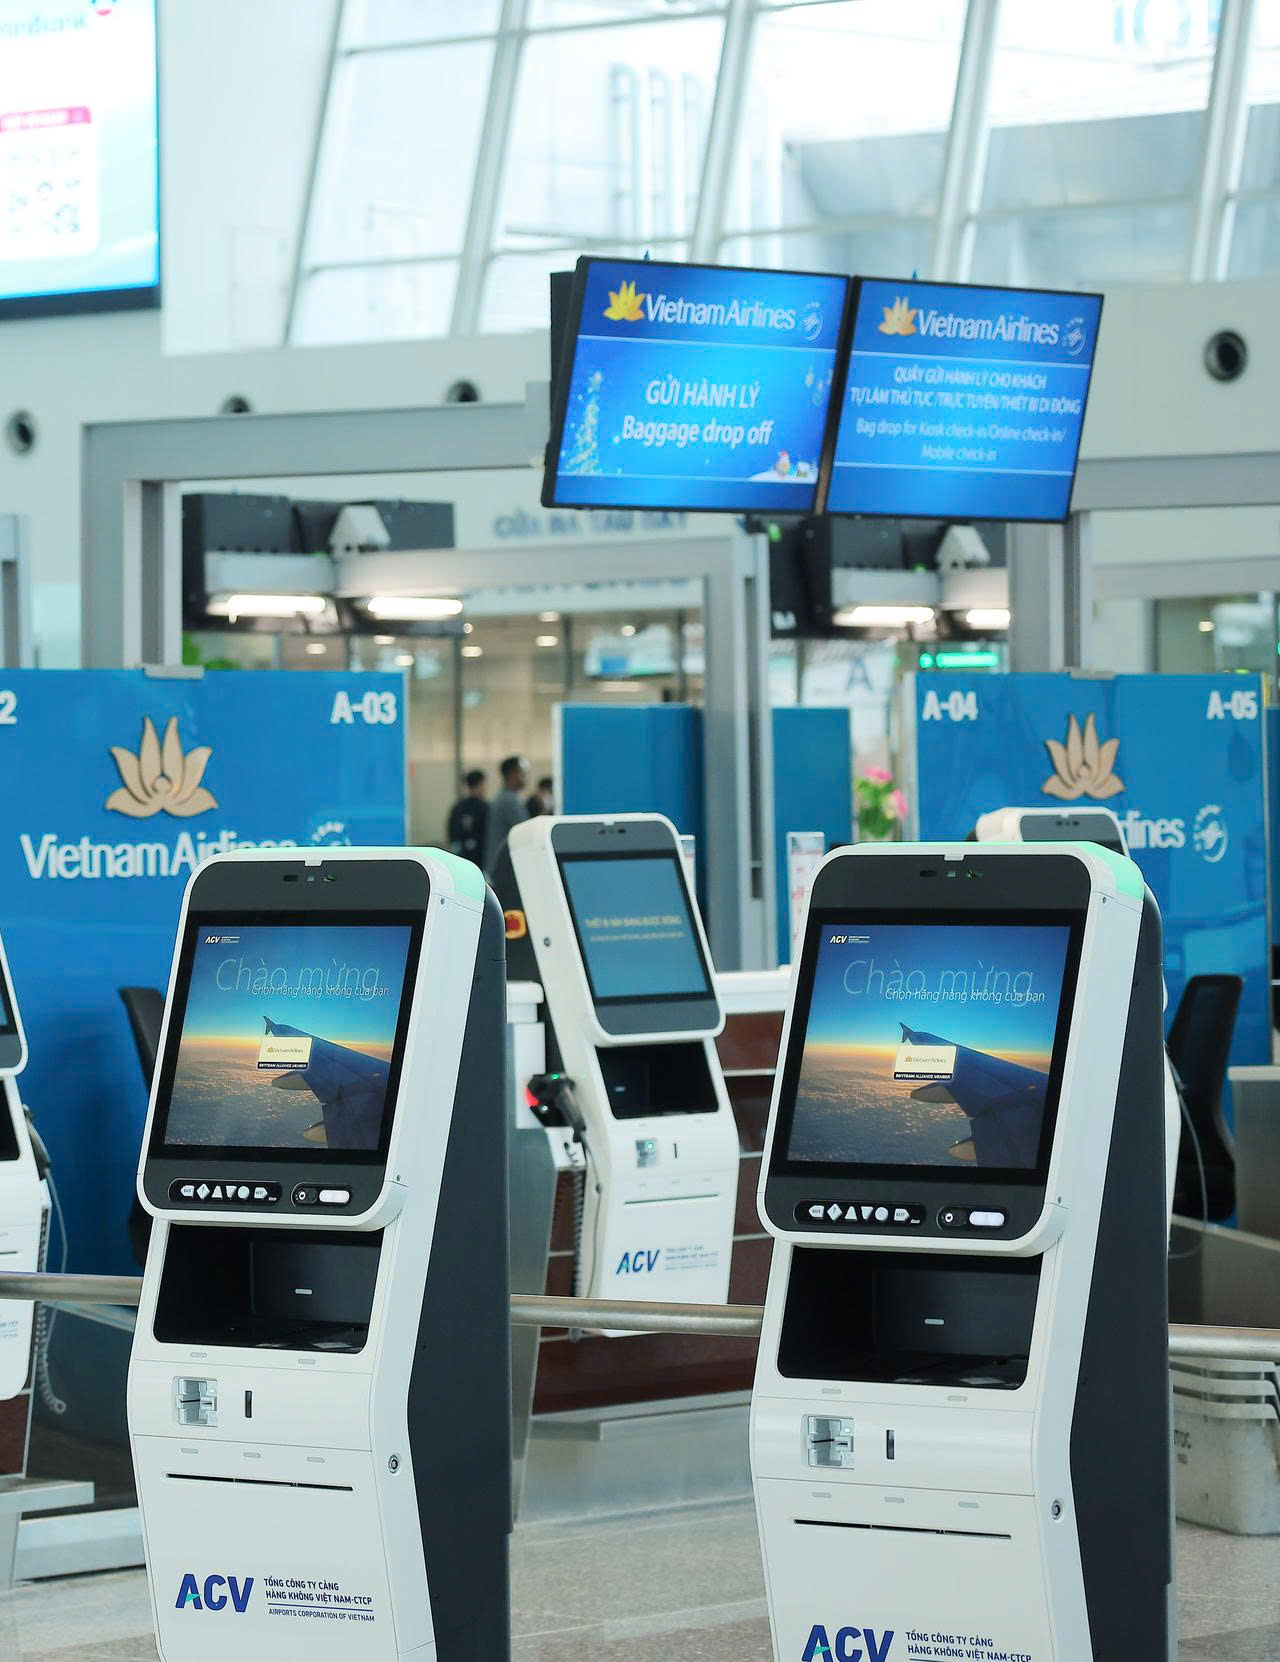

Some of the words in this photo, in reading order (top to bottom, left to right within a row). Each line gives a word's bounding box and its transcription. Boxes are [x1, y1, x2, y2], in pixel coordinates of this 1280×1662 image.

[645, 373, 680, 405] GỬI
[682, 377, 736, 408] HÀNH
[739, 380, 760, 409] LÝ
[622, 415, 700, 448] Baggage
[703, 417, 744, 448] drop
[747, 419, 774, 445] off
[331, 691, 397, 724] A-03
[923, 691, 978, 721] A-04
[1207, 691, 1257, 719] A-05
[20, 832, 171, 880] Vietnam
[204, 936, 221, 944] ACV
[829, 935, 848, 944] ACV
[216, 957, 287, 991] Chào
[298, 957, 380, 1001] mừng
[325, 983, 352, 998] không
[372, 984, 390, 997] bạn
[843, 959, 926, 995] Chào
[939, 960, 1033, 1007] mừng
[885, 987, 912, 1001] Chọn
[942, 988, 968, 1003] hàng
[971, 988, 1002, 1003] không
[1004, 988, 1024, 1001] của
[1026, 988, 1045, 1003] bạn
[616, 1250, 660, 1275] ACV
[175, 1573, 255, 1613] ACV
[263, 1575, 284, 1588] TỔNG
[285, 1578, 306, 1589] CÔNG
[307, 1581, 317, 1590] TY
[318, 1579, 339, 1591] CẢNG
[265, 1589, 287, 1600] HÀNG
[288, 1590, 314, 1602] KHÔNG
[315, 1593, 333, 1605] VIỆT
[268, 1608, 297, 1617] AIRPORTS
[298, 1610, 338, 1620] CORPORATION
[348, 1614, 375, 1622] VIETNAM
[801, 1624, 895, 1662] ACV
[906, 1629, 929, 1642] TỔNG
[931, 1632, 954, 1644] CÔNG
[956, 1635, 967, 1645] TY
[969, 1634, 993, 1647] CẢNG
[907, 1644, 932, 1655] HÀNG
[933, 1646, 964, 1658] KHÔNG
[965, 1648, 985, 1660] VIỆT
